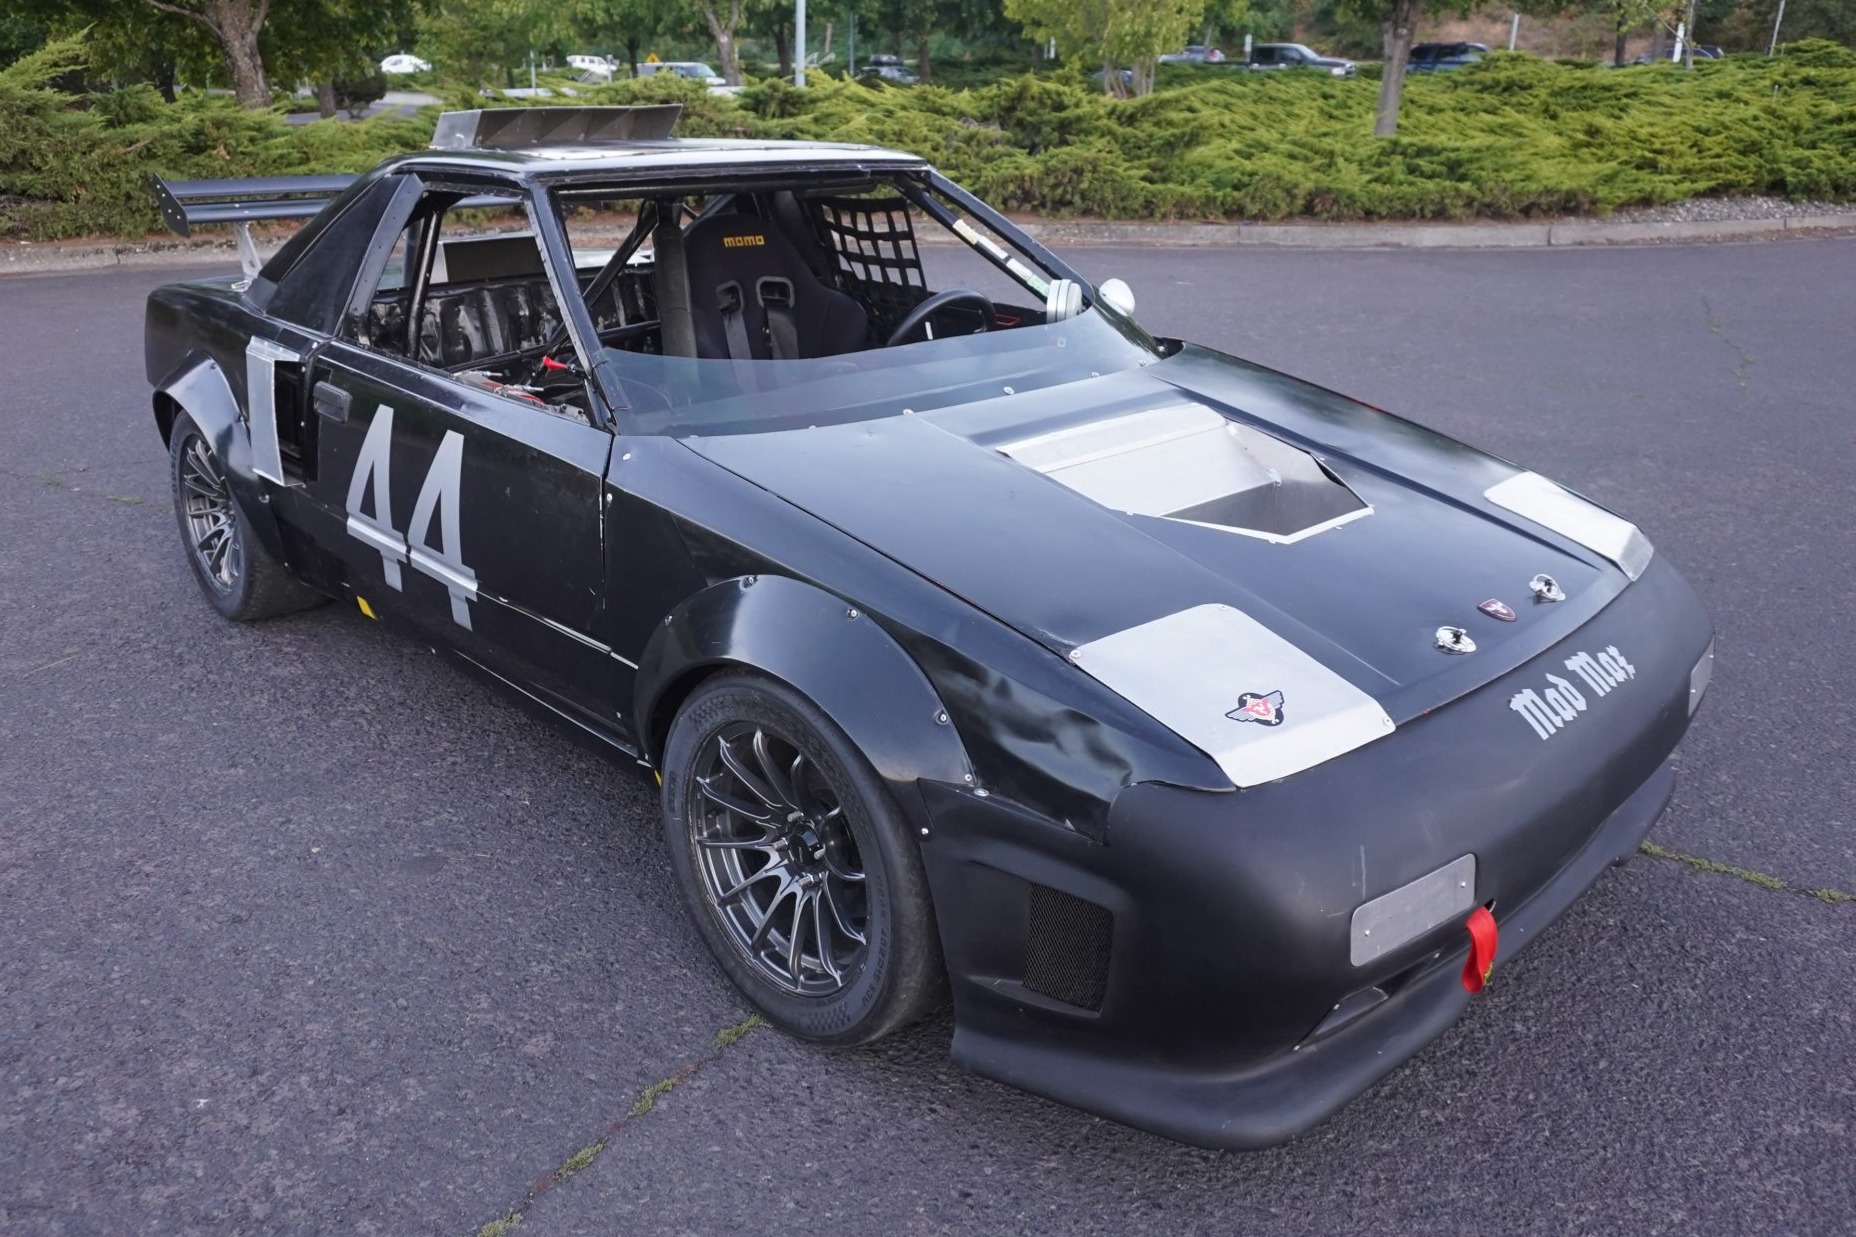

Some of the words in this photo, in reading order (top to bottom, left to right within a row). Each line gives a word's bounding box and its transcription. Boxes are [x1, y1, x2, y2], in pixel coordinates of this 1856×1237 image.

[345, 403, 479, 632] 44
[1509, 672, 1587, 741] Mad
[1563, 644, 1636, 698] Max
